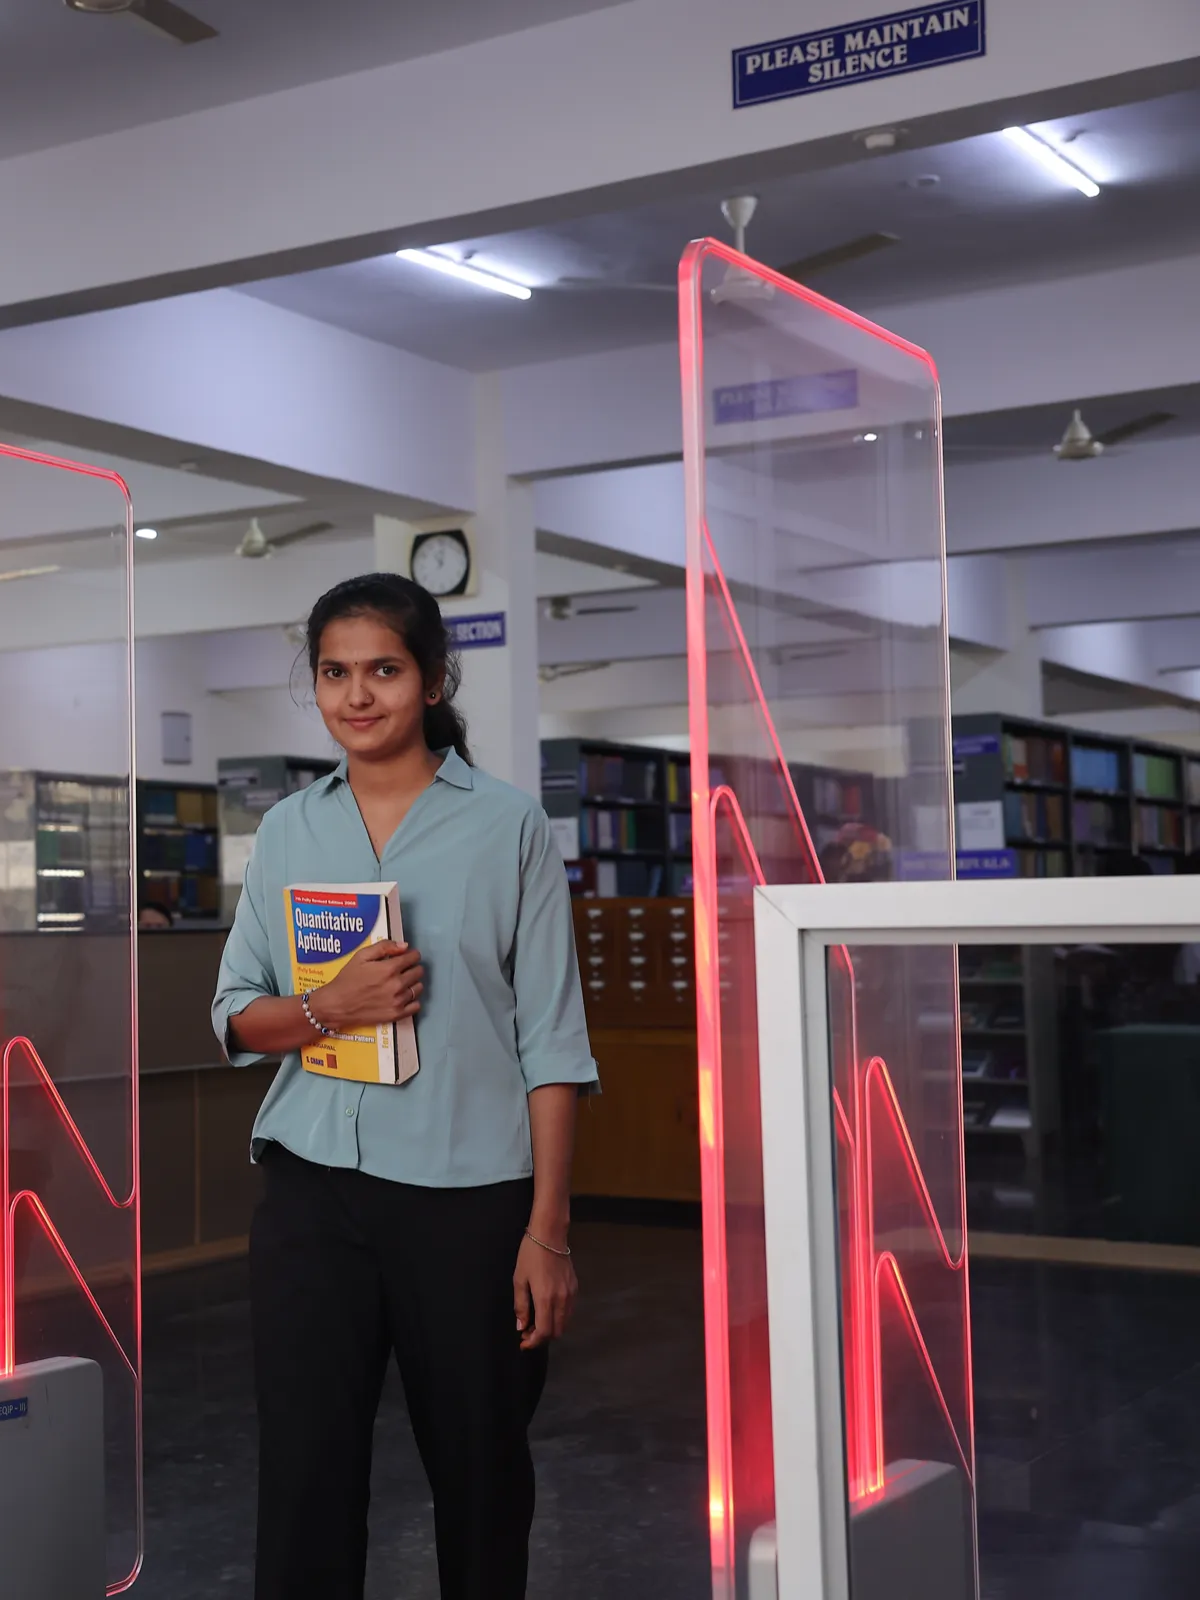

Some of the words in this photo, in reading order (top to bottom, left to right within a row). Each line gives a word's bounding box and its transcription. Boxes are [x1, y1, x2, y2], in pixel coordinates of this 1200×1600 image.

[746, 38, 834, 75] PLEASE
[844, 7, 970, 53] MAINTAIN
[808, 44, 908, 84] SILENCE
[456, 620, 502, 642] SECTION
[295, 907, 364, 933] Quantitative
[298, 930, 341, 954] Aptitude
[354, 1035, 375, 1043] Pattern
